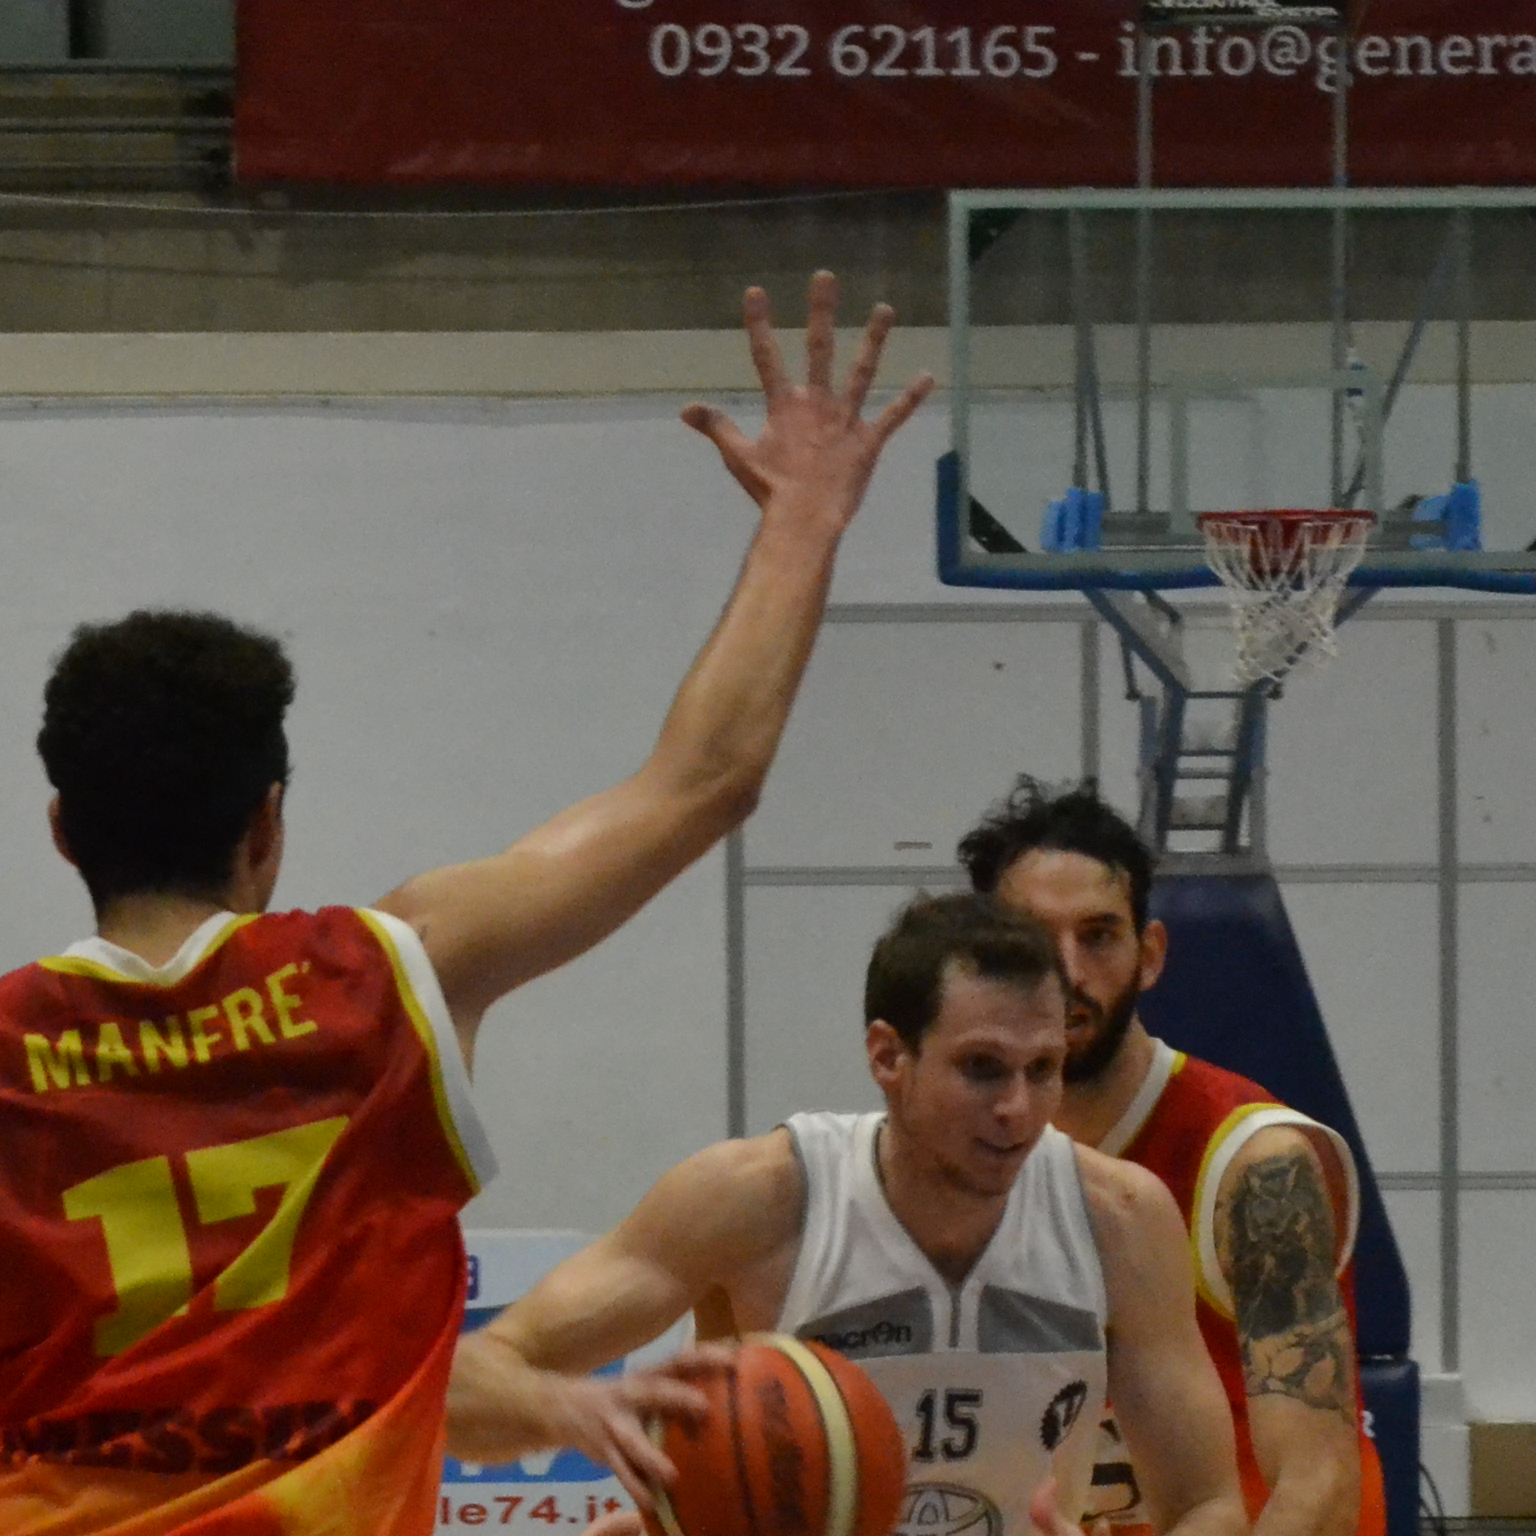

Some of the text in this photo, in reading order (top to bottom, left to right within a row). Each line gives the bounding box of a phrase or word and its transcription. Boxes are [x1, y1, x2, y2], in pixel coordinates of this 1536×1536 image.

[649, 22, 812, 77] 0932
[829, 24, 1059, 78] 621165
[61, 1114, 351, 1357] 17
[910, 1386, 985, 1464] 15
